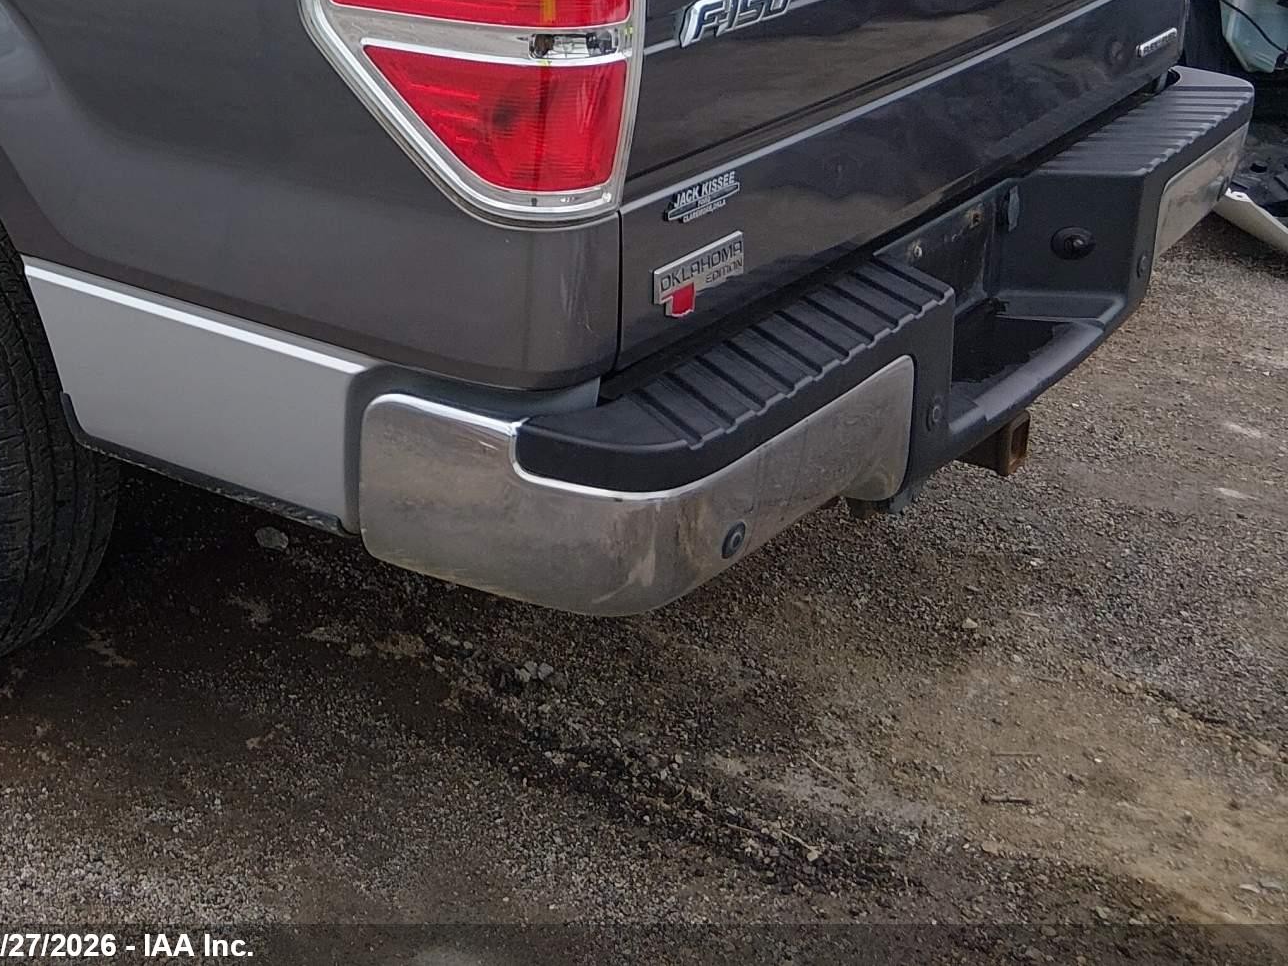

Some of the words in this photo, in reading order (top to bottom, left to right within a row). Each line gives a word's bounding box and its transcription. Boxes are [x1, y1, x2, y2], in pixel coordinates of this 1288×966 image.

[674, 185, 700, 208] JACK
[702, 171, 736, 195] KISSEE
[661, 240, 742, 291] OKLAHOMA
[705, 258, 744, 284] EDITION
